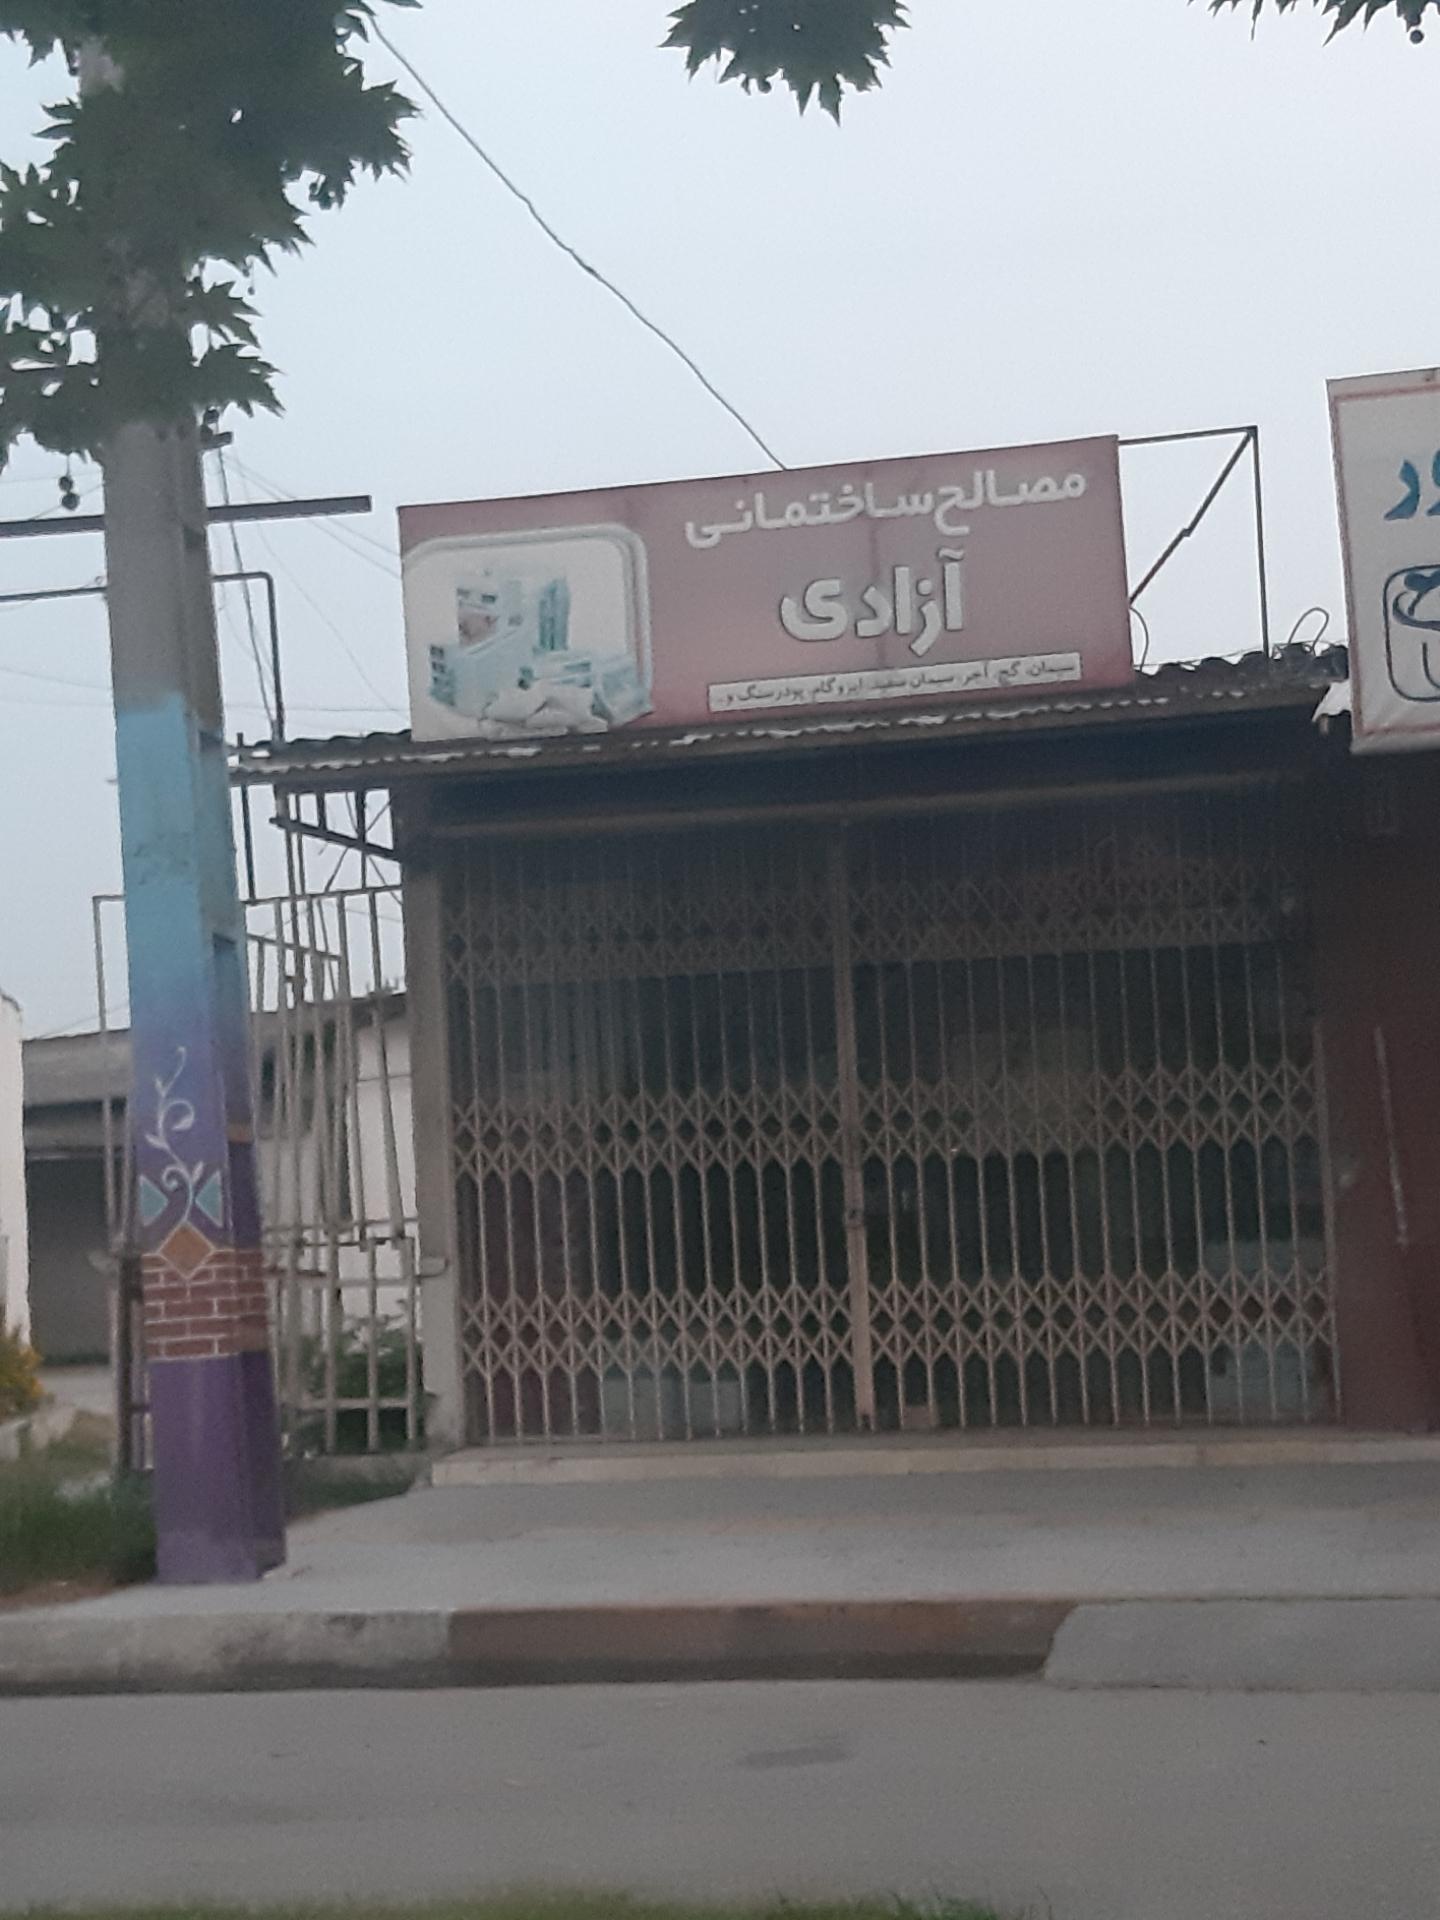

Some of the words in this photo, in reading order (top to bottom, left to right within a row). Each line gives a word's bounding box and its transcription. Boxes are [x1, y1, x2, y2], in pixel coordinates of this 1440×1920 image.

[684, 482, 935, 549] ساختمانی
[934, 469, 1087, 536] مصالح
[778, 547, 966, 657] آزادی
